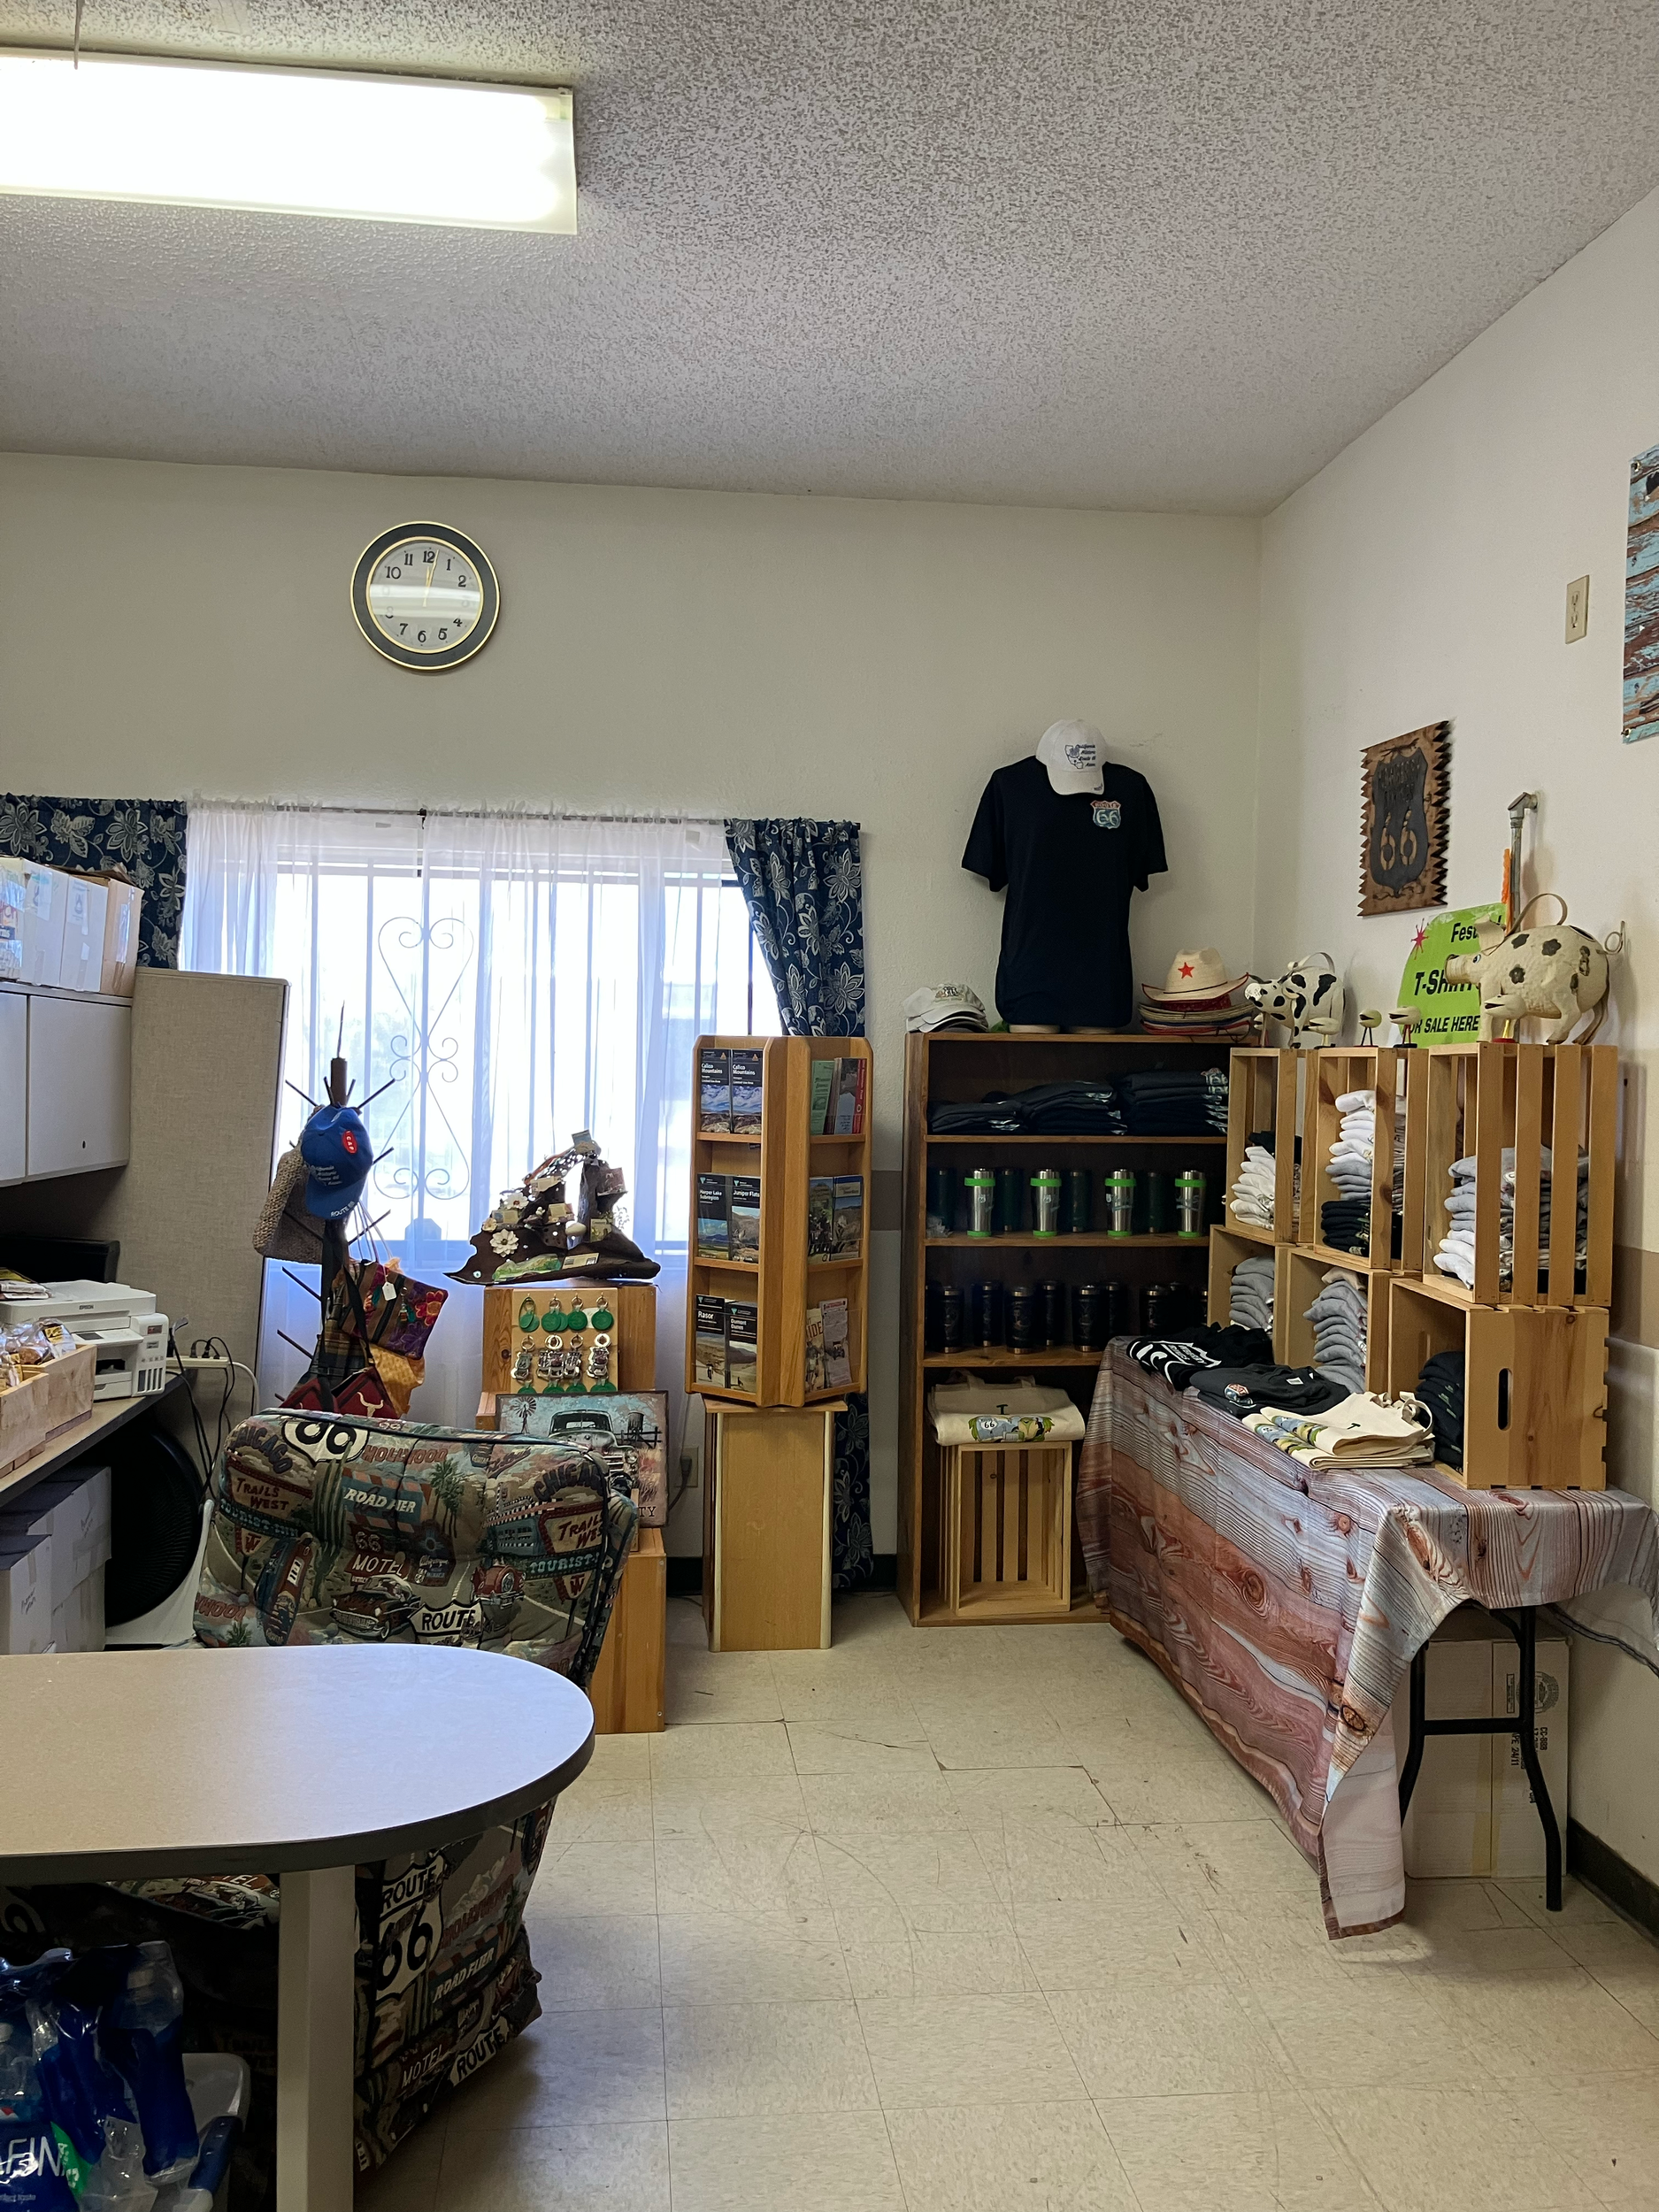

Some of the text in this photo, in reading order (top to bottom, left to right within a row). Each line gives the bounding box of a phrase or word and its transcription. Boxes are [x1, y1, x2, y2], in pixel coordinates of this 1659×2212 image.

[404, 553, 413, 565] 11
[423, 550, 435, 564] 12
[447, 559, 451, 571] 1
[386, 566, 402, 580] 10
[457, 575, 466, 588] 2
[400, 623, 408, 635] 7
[418, 630, 426, 643] 6
[438, 628, 448, 641] 5
[1096, 810, 1119, 826] 66
[1380, 806, 1417, 871] 66
[1425, 1017, 1450, 1033] SALE
[1451, 1015, 1481, 1033] HERE
[330, 1206, 349, 1217] ROUTE
[698, 1310, 714, 1319] Rasor
[236, 1477, 281, 1498] TRAILS
[250, 1495, 290, 1511] WEST
[344, 1487, 388, 1508] ROAD
[355, 1531, 381, 1553] 66
[351, 1554, 404, 1576] MOTEL
[421, 1609, 476, 1632] ROUTE
[382, 1865, 437, 1909] ROUTE
[376, 1901, 434, 1992] 66
[433, 1967, 467, 2004] ROAD
[457, 2026, 503, 2082] ROUTE
[402, 2044, 443, 2090] MOTEL
